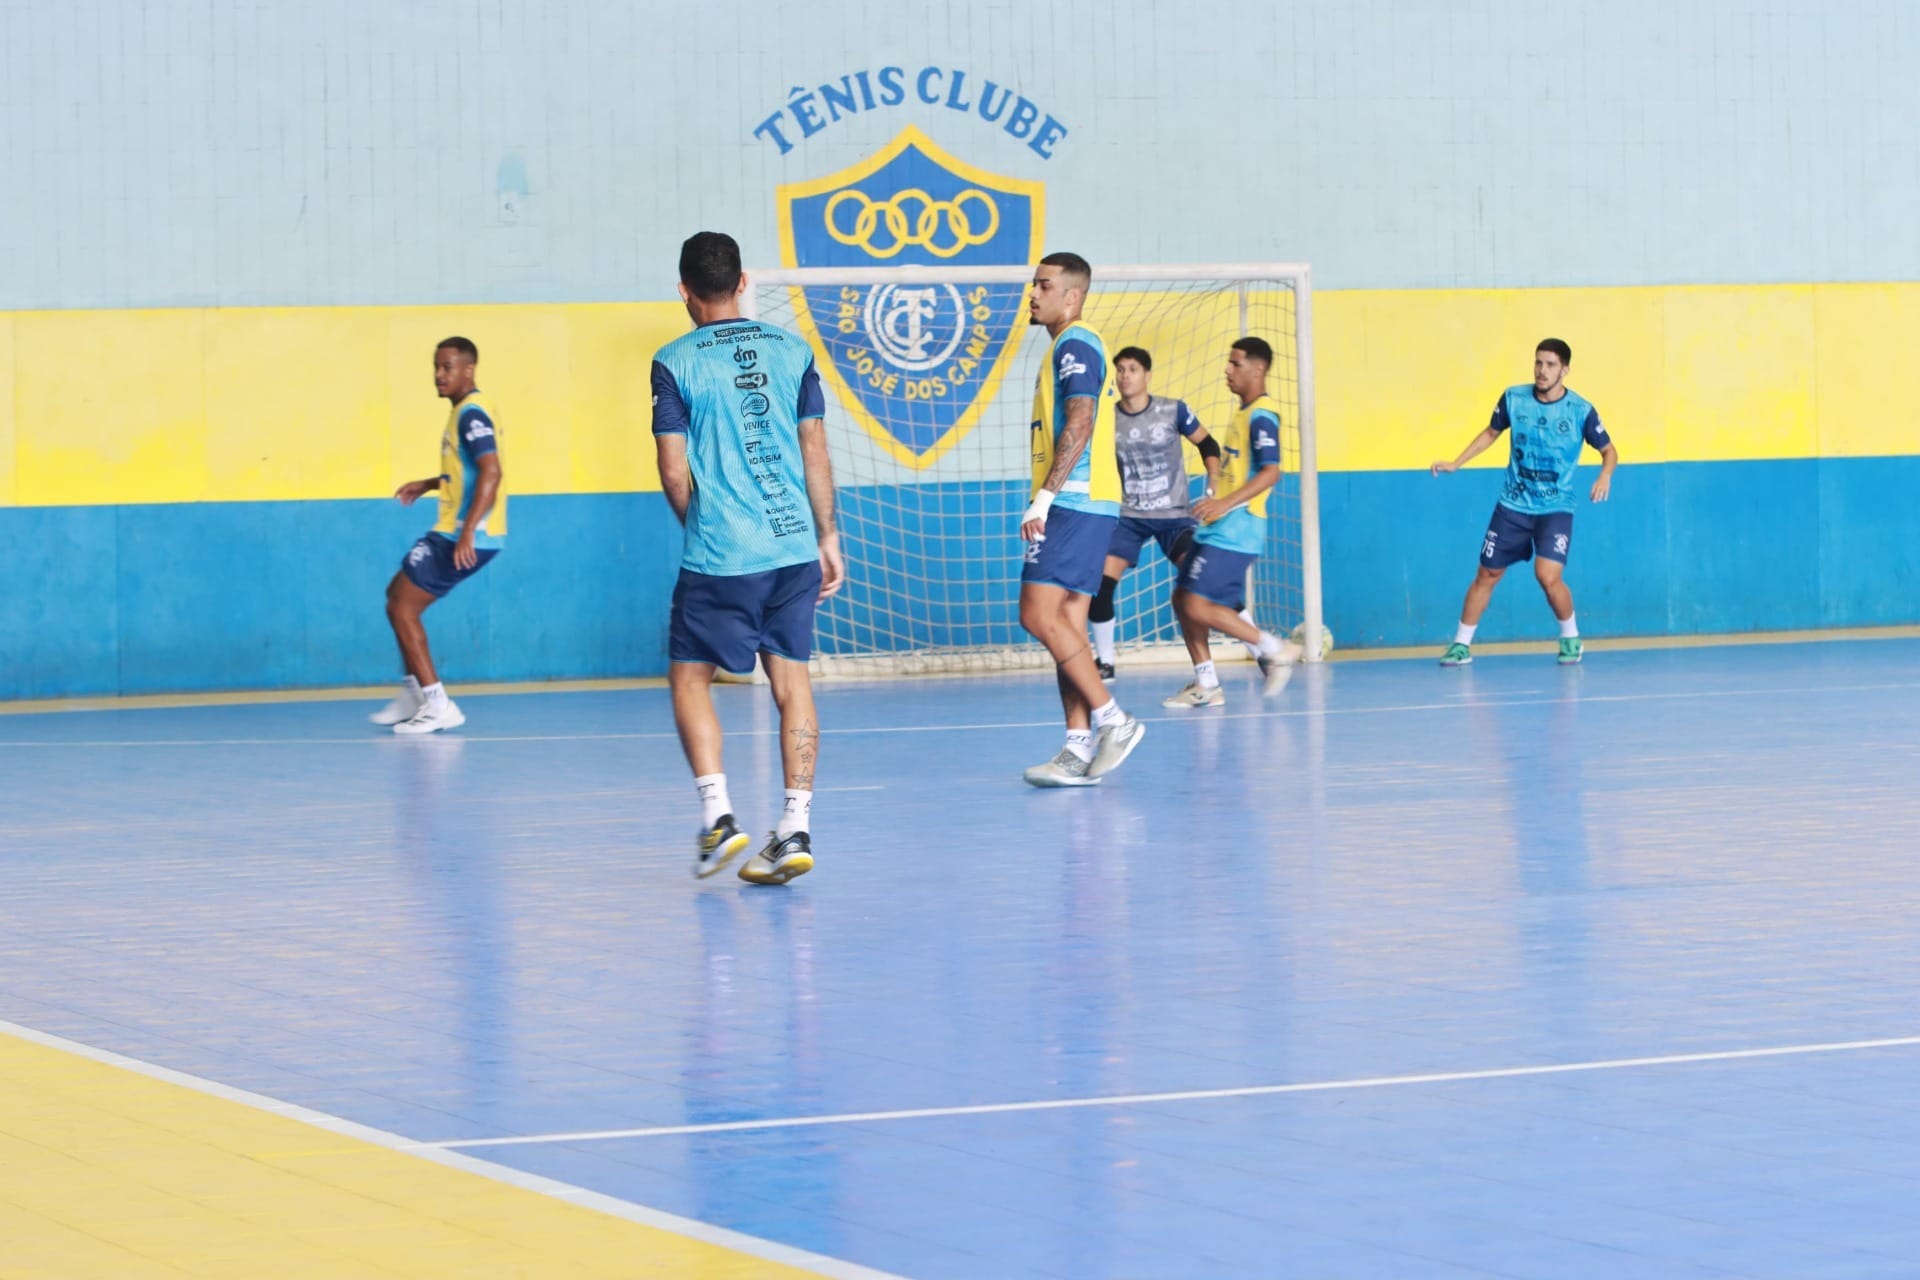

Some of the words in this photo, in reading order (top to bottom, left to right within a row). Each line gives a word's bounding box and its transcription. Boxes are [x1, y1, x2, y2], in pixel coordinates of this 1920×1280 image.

[753, 66, 905, 155] TÊNIS
[916, 66, 1068, 160] CLUBE
[838, 286, 860, 333] SÃO
[735, 335, 751, 343] DOS
[752, 333, 784, 341] CAMPOS
[947, 286, 991, 385] CAMPOS
[846, 347, 898, 395] JOSÉ
[905, 376, 947, 400] DOS
[744, 420, 770, 431] VENICE
